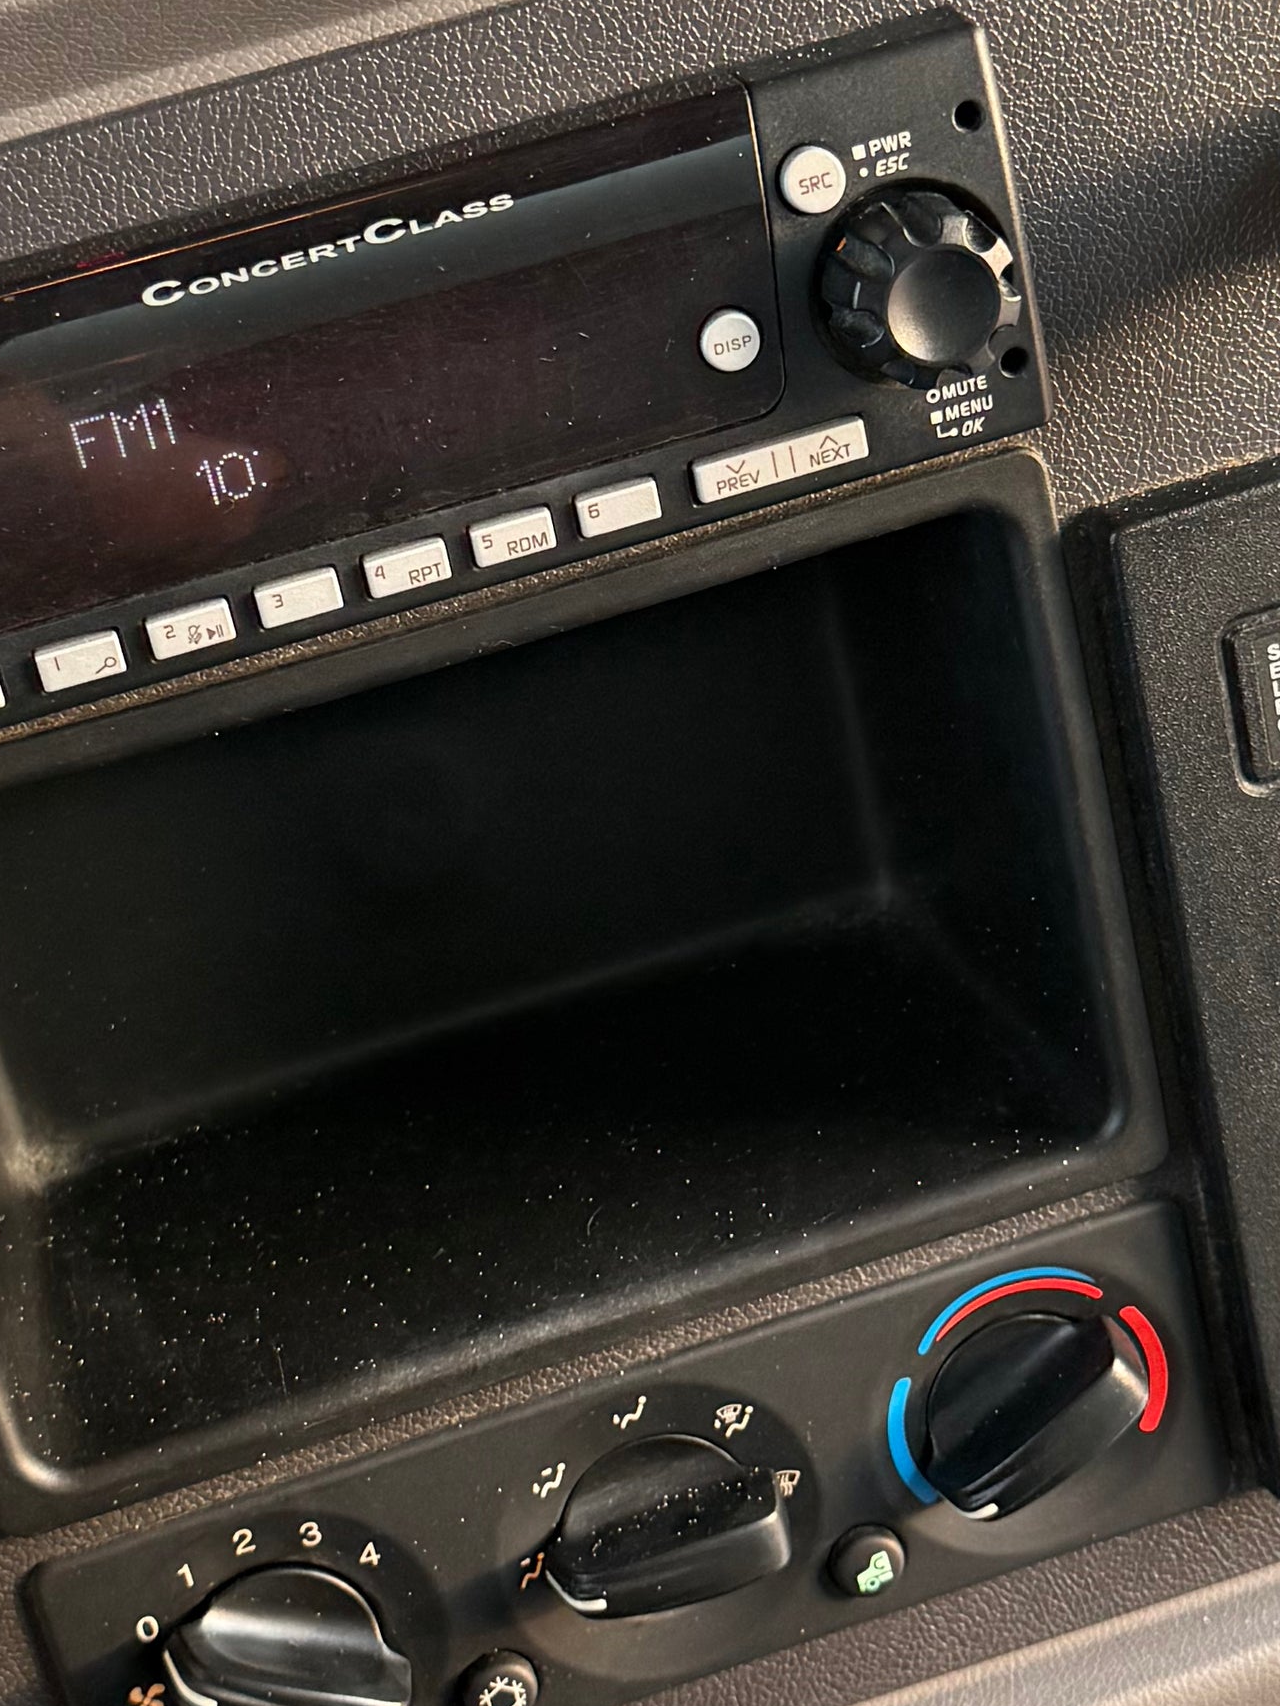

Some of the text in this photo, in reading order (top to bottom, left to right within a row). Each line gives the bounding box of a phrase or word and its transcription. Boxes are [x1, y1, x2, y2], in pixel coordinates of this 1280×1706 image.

[868, 131, 912, 157] PWR
[875, 152, 910, 177] ESC
[798, 172, 833, 195] SRC
[713, 333, 753, 355] DISP
[941, 375, 988, 400] MUTE
[945, 394, 994, 421] MENU
[961, 416, 986, 437] OK
[809, 443, 852, 468] NEXT
[716, 469, 760, 494] PREV
[587, 503, 600, 519] 6
[481, 531, 549, 556] 5 RDM
[374, 561, 443, 585] 4 RPT
[273, 594, 284, 609] 3
[163, 625, 176, 640] 2
[177, 1563, 195, 1589] 1
[232, 1528, 257, 1555] 2
[299, 1521, 323, 1548] 3
[359, 1541, 382, 1567] 4
